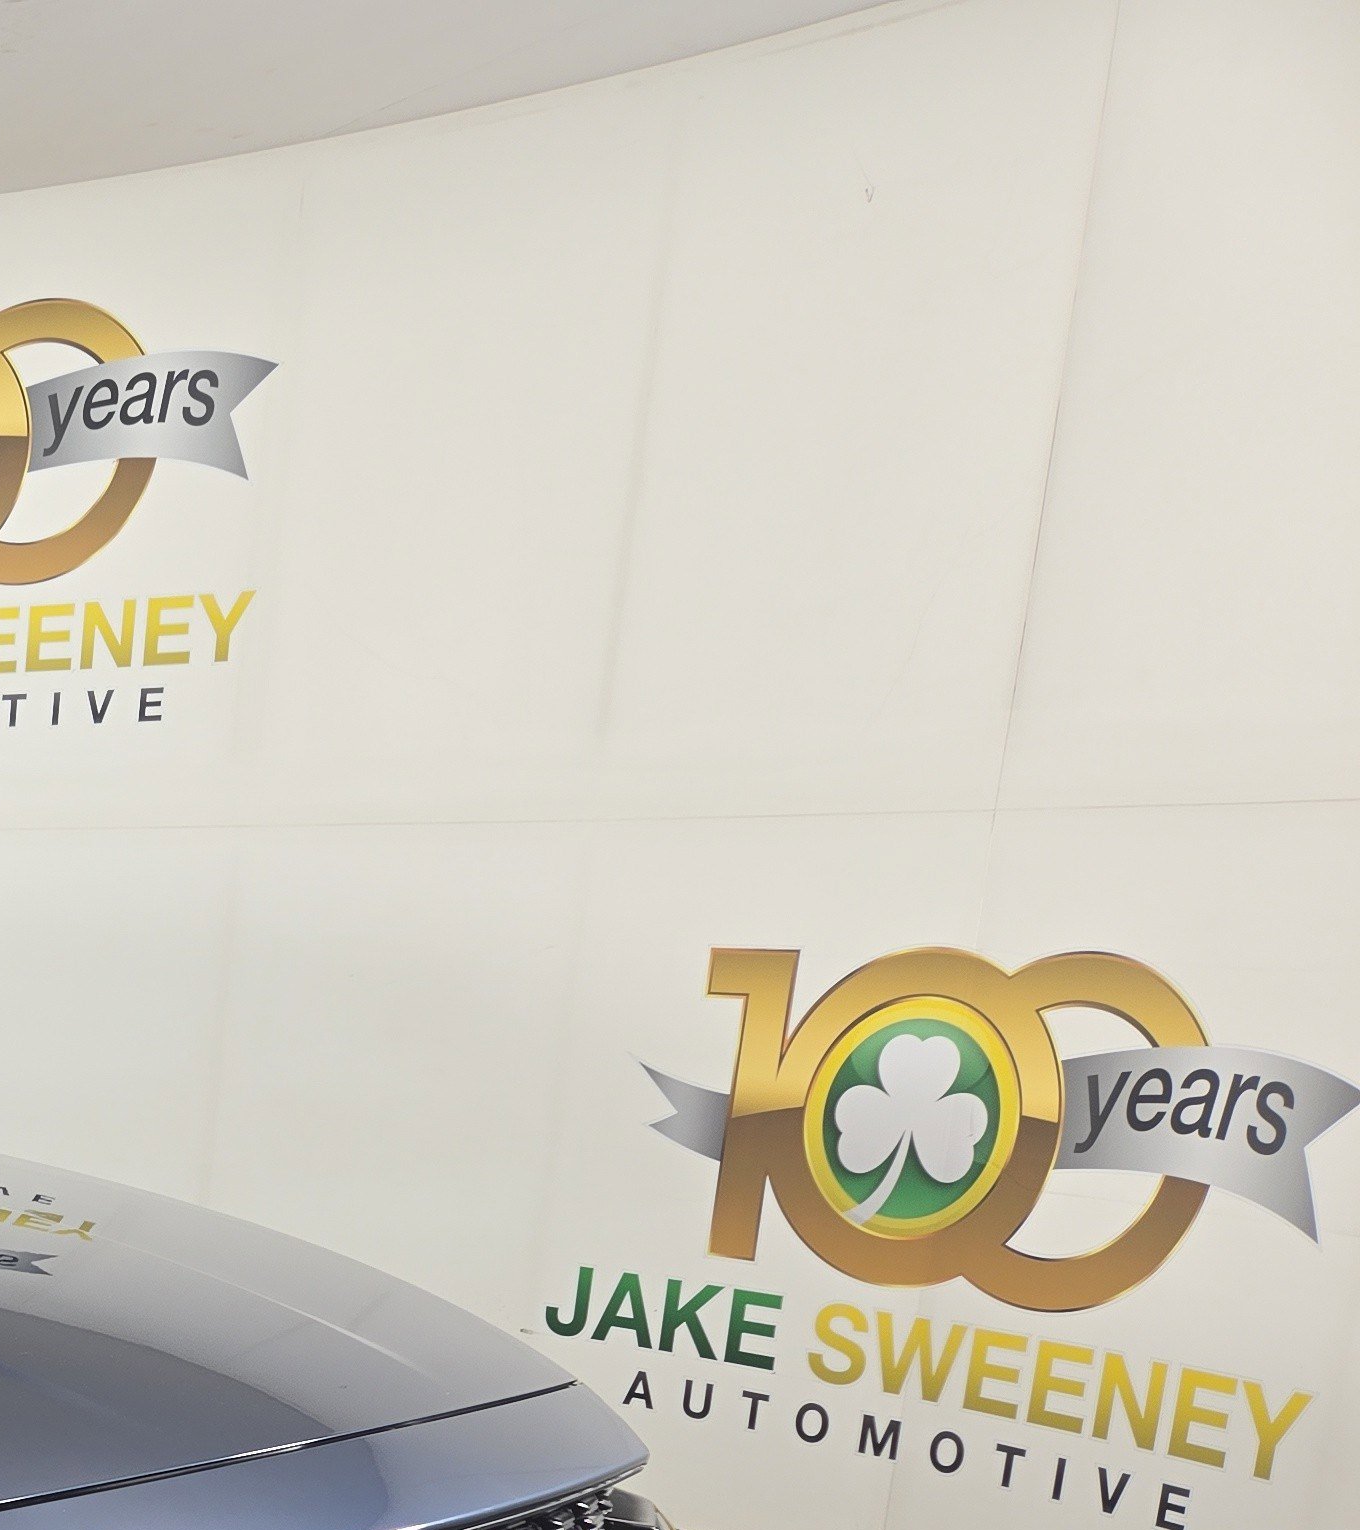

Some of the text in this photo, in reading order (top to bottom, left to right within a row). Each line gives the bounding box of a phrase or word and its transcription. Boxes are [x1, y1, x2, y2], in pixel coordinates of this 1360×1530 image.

[43, 366, 220, 457] years
[1073, 1067, 1296, 1157] years
[544, 1266, 1315, 1483] JAKE SWEENEY
